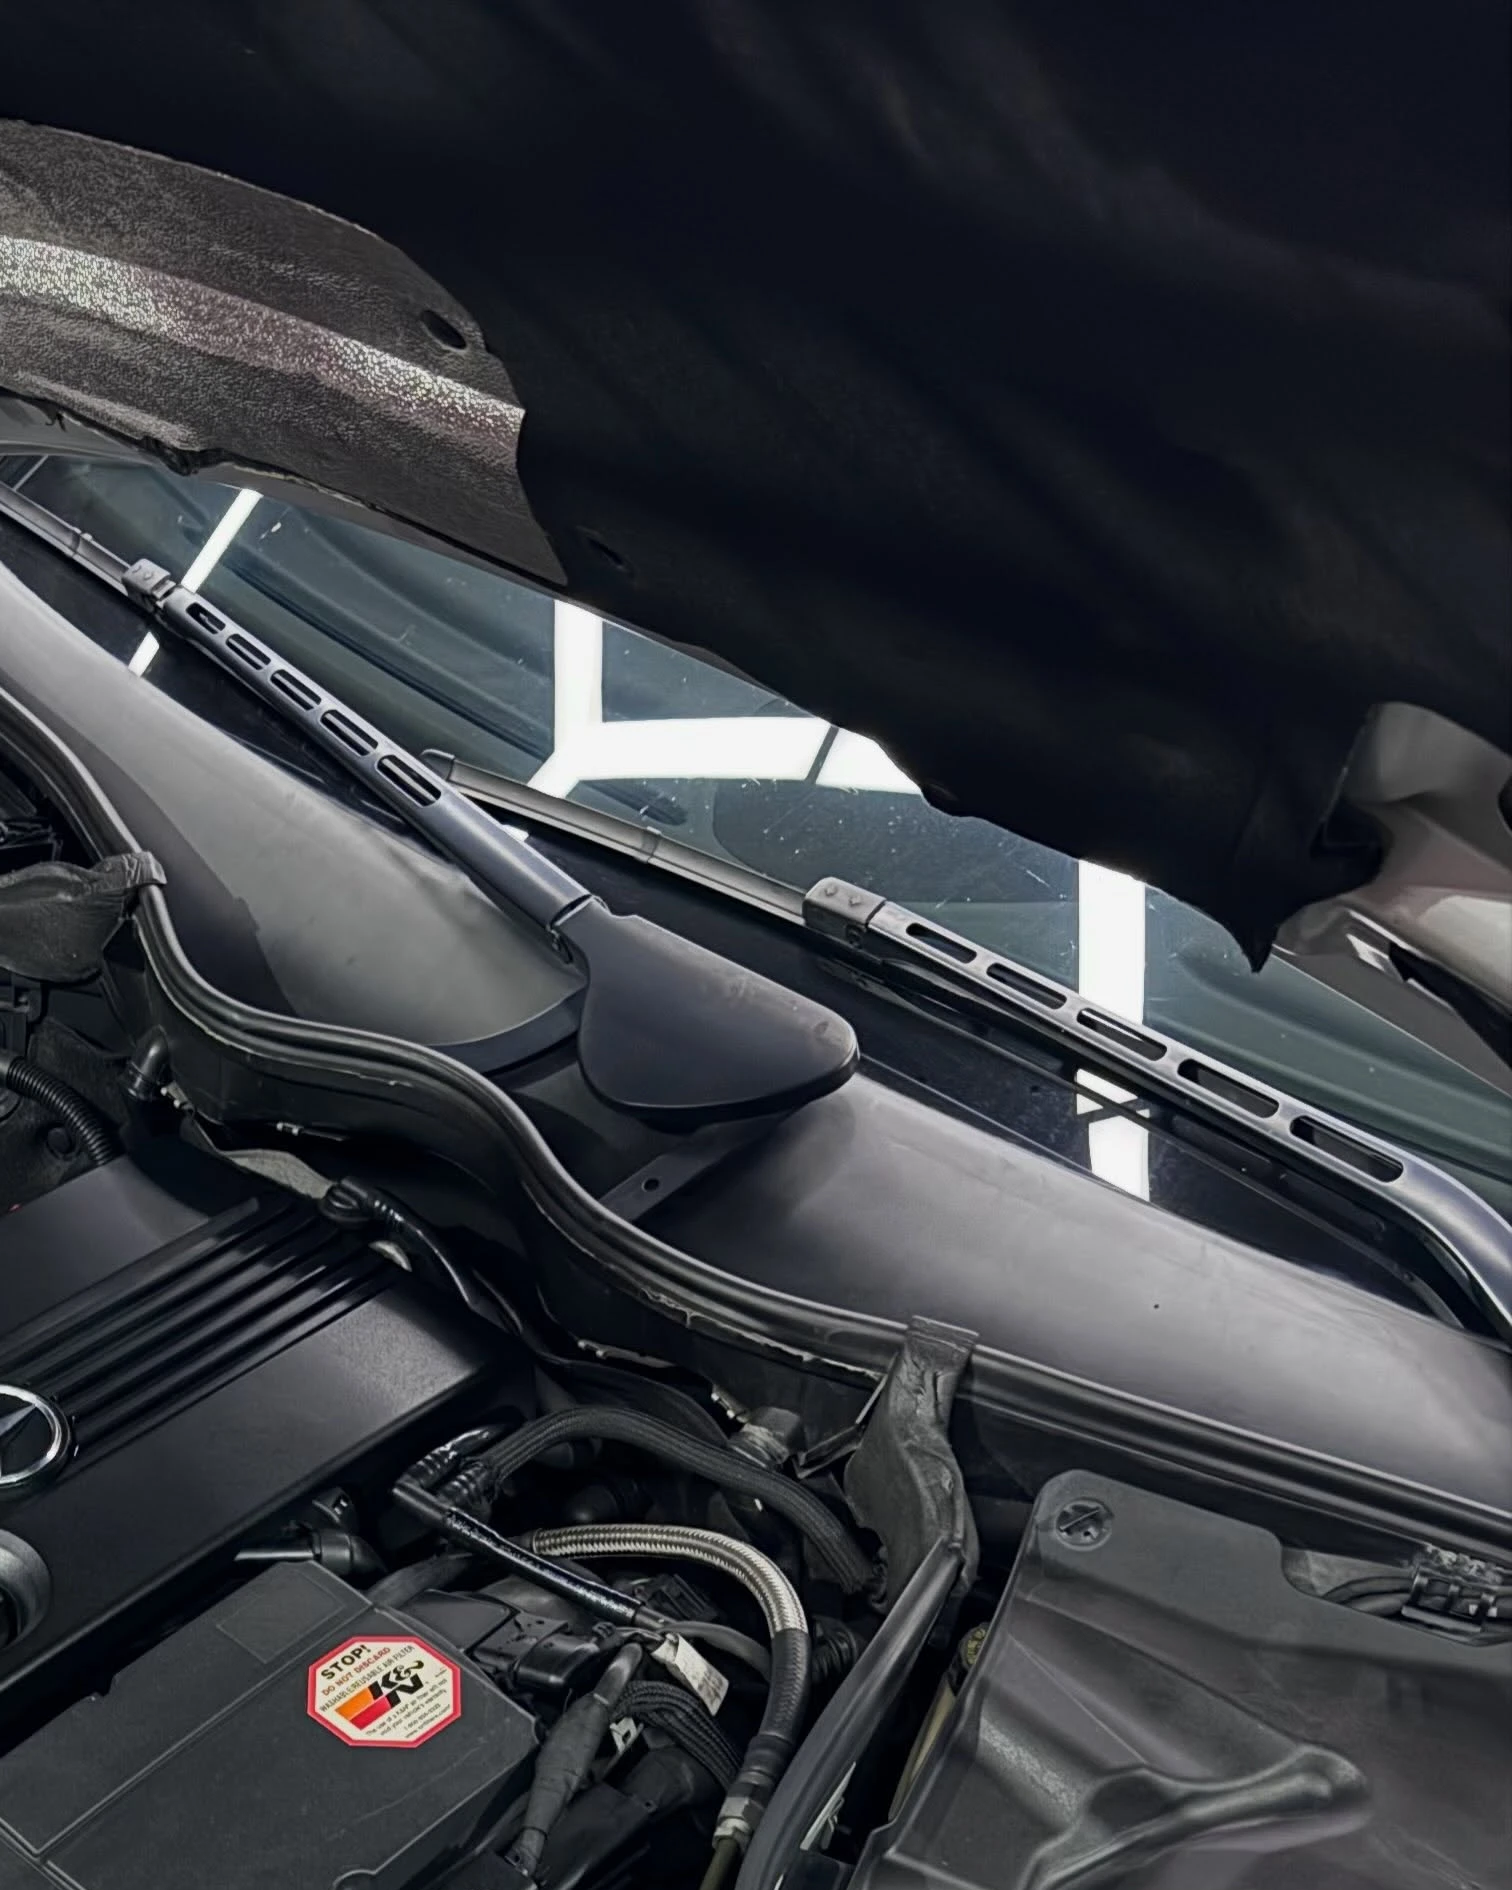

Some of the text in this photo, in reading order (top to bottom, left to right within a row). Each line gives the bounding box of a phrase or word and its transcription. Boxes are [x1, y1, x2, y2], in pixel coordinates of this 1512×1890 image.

[321, 1645, 371, 1680] STOP!
[322, 1647, 391, 1696] DO NOT DISCARD
[393, 1645, 414, 1662] FILTER
[368, 1660, 424, 1708] K&N
